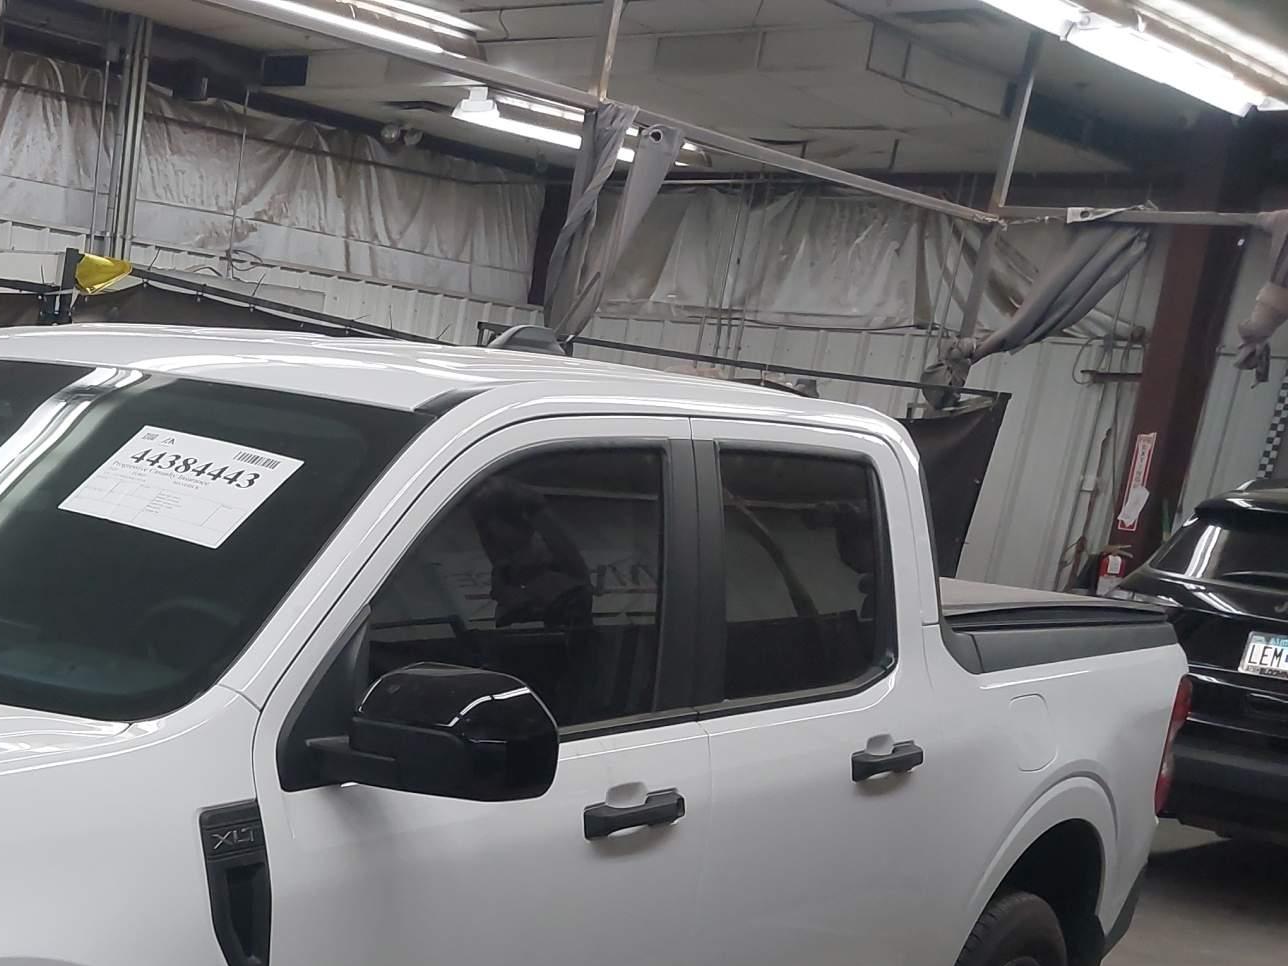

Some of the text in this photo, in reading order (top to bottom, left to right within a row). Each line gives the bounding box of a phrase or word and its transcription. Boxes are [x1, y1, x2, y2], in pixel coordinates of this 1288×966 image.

[130, 448, 261, 489] 44384443
[1247, 644, 1284, 668] LEM
[211, 827, 255, 850] XLT
